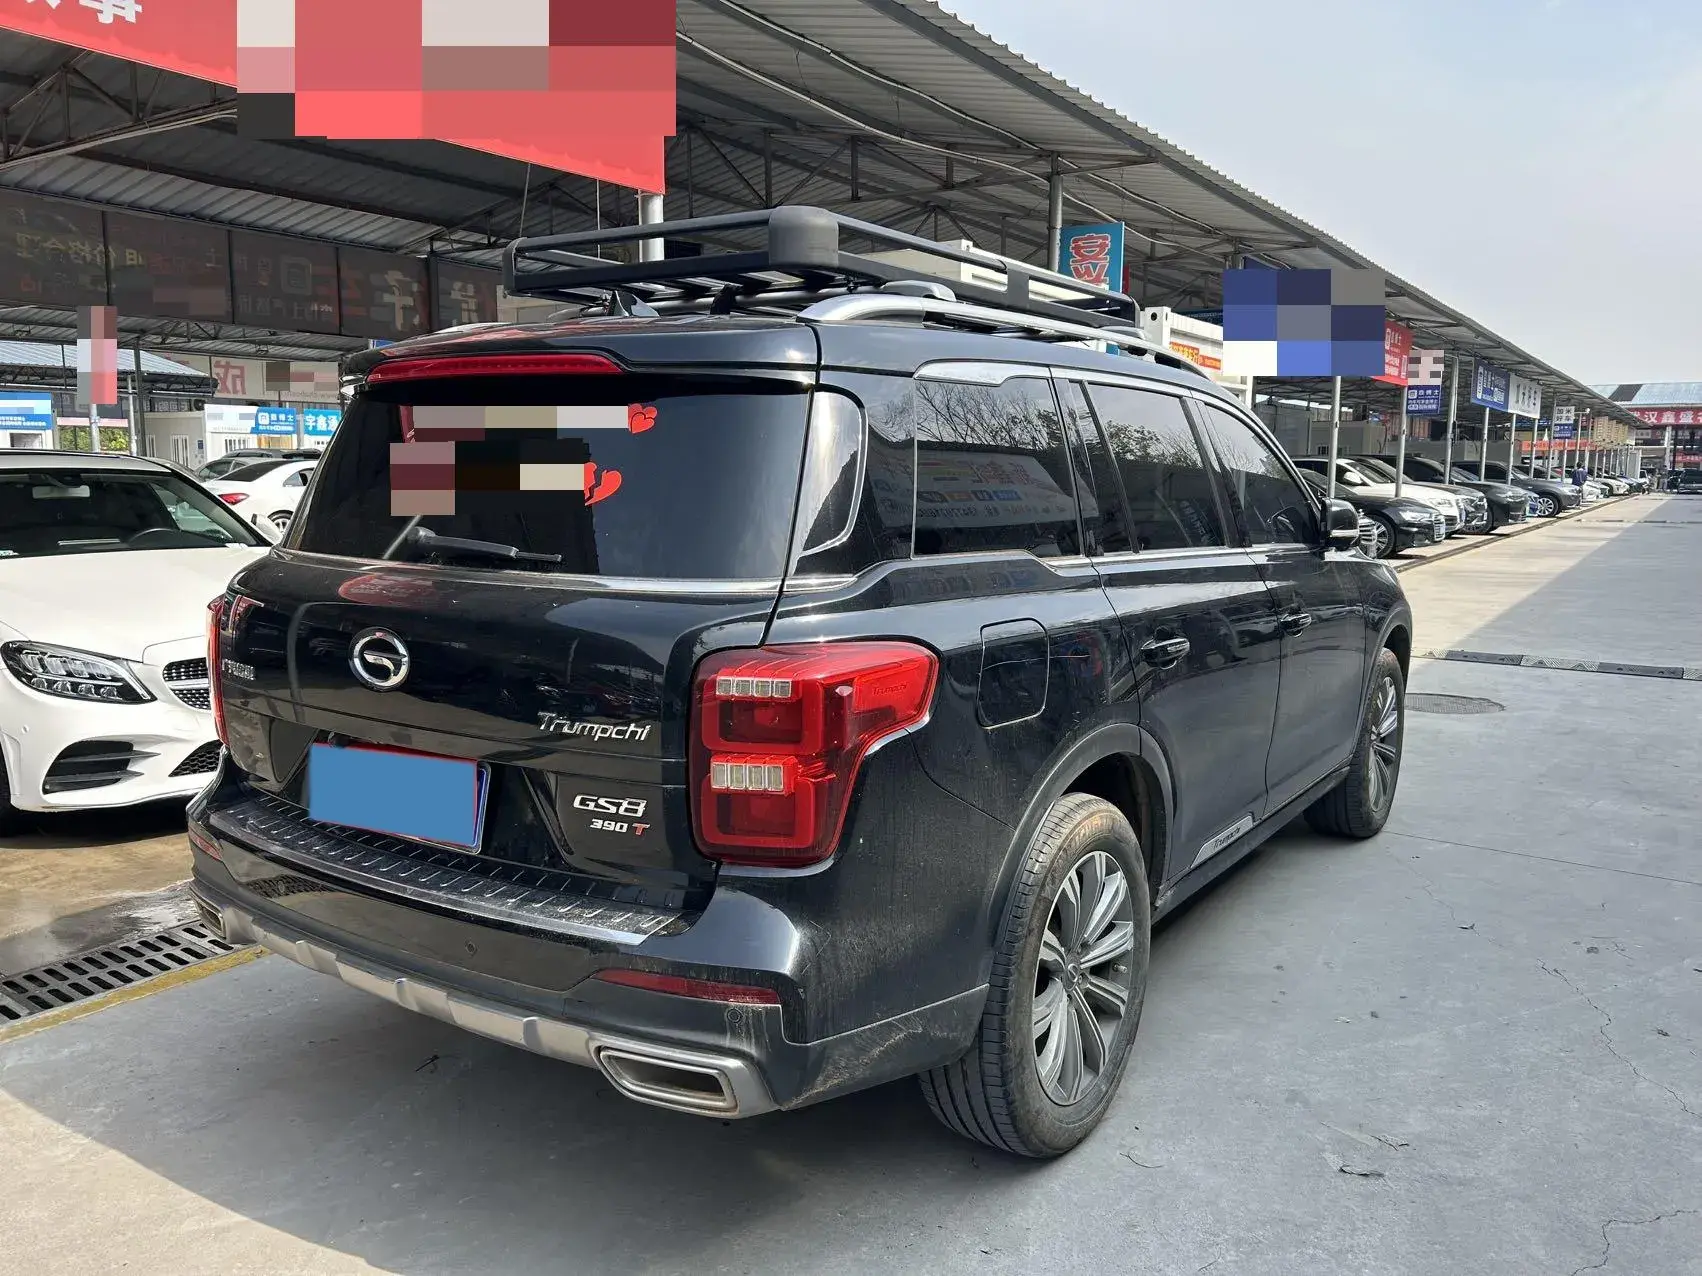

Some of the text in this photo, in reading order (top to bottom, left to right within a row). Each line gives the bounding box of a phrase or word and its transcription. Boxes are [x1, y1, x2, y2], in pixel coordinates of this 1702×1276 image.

[538, 711, 652, 741] Trumpchi
[573, 794, 648, 818] GS8
[590, 818, 651, 836] 390 T
